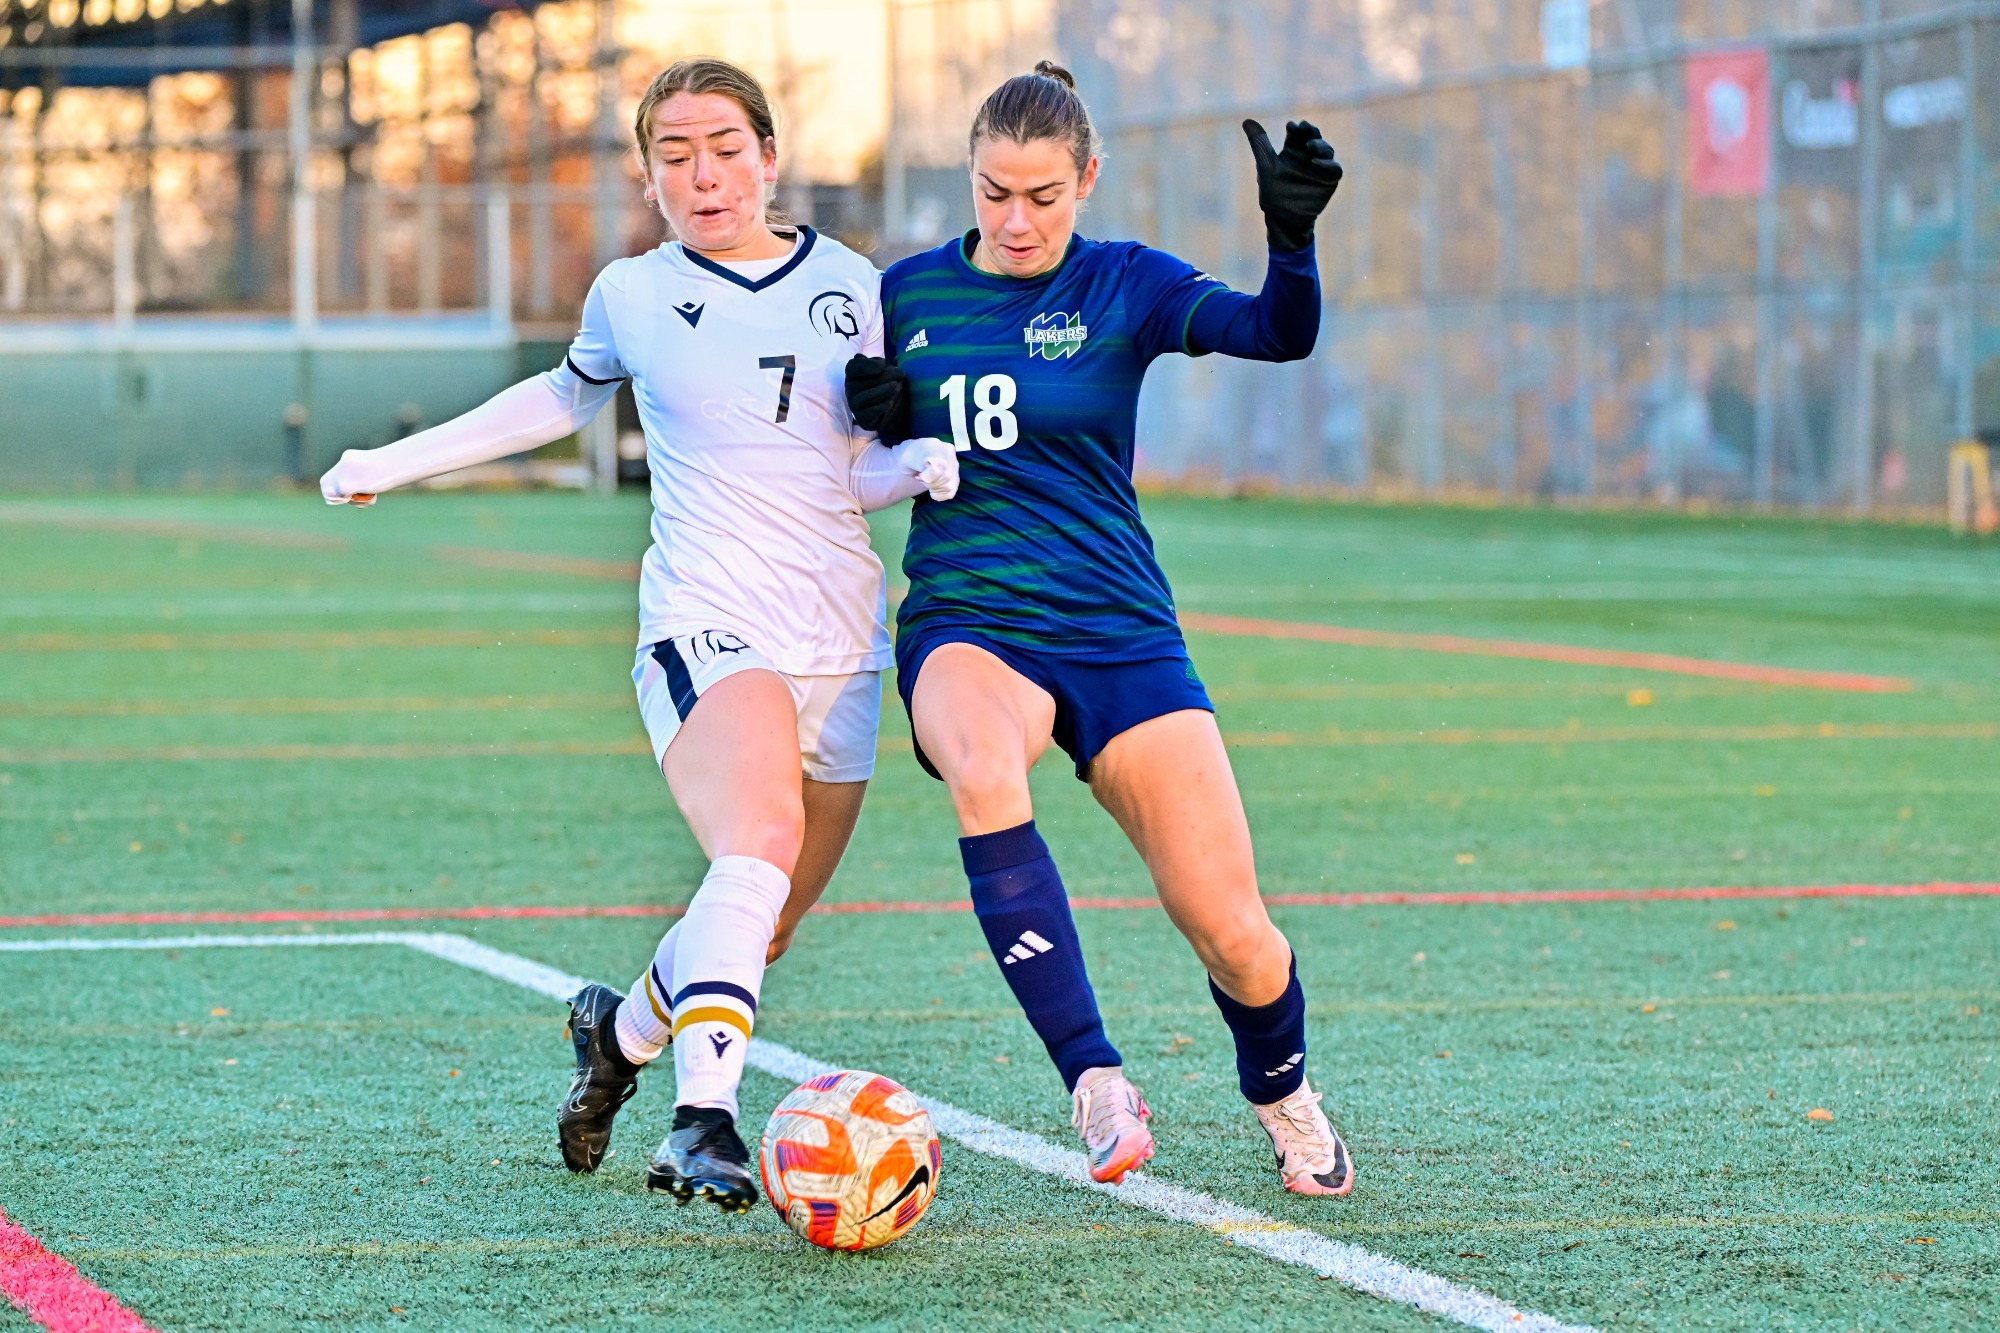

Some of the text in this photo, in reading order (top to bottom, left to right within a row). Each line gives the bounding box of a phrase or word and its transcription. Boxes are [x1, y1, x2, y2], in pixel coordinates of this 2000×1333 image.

[1023, 325, 1087, 343] LAKERS
[758, 354, 796, 424] 7
[940, 373, 1018, 452] 18
